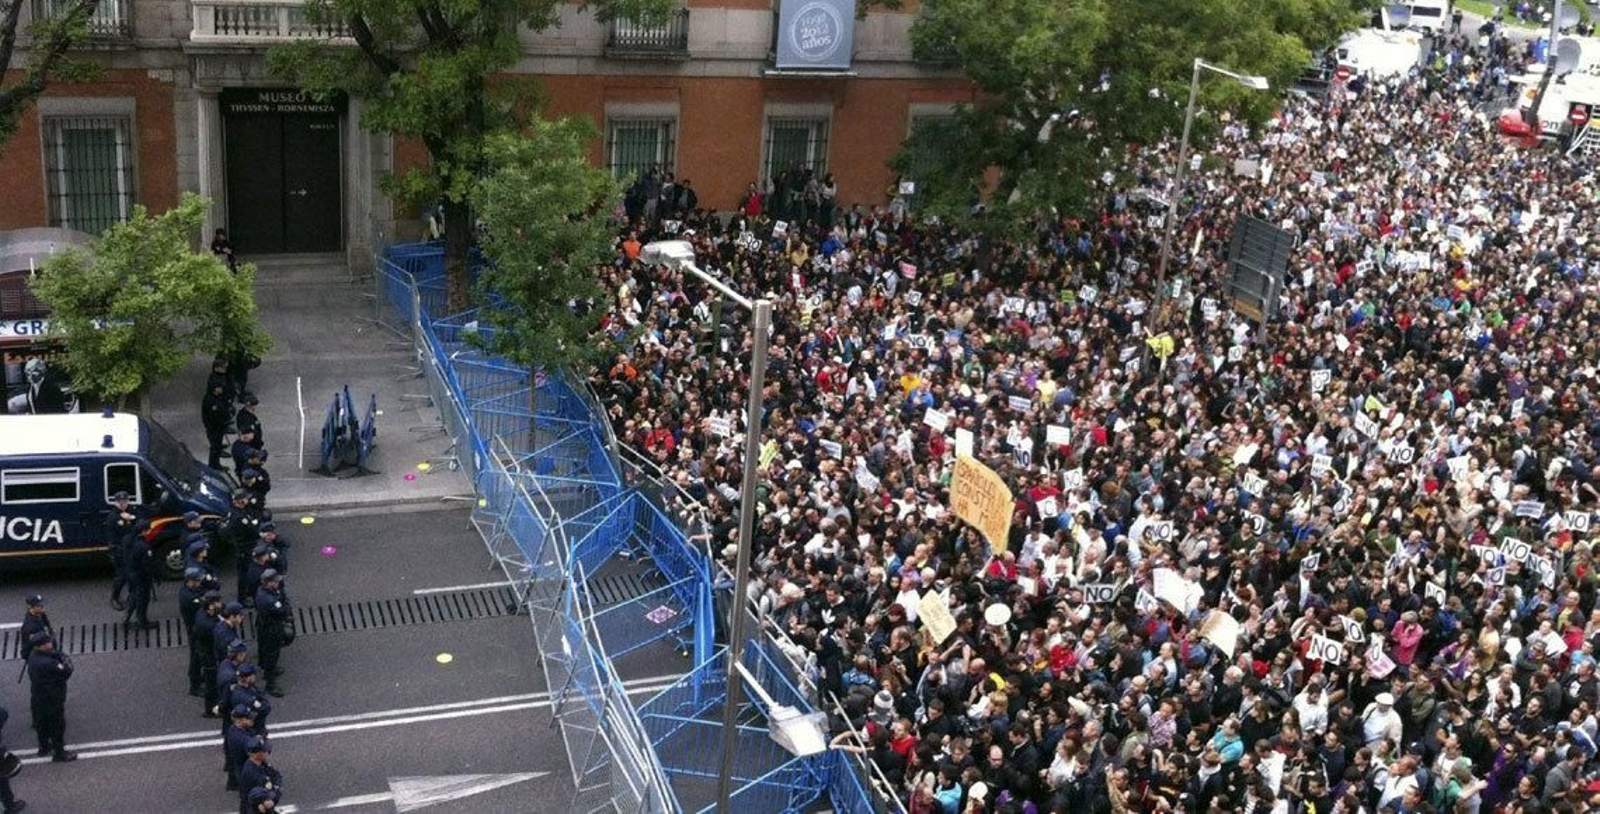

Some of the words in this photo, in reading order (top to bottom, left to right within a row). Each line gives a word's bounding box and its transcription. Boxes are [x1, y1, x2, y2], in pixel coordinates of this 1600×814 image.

[259, 92, 306, 102] MUSEO
[1015, 448, 1030, 468] NO
[1390, 447, 1412, 461] NO
[1565, 513, 1587, 529] NO
[1503, 540, 1528, 559] NO
[1086, 587, 1114, 601] NO
[1311, 638, 1338, 661] NO
